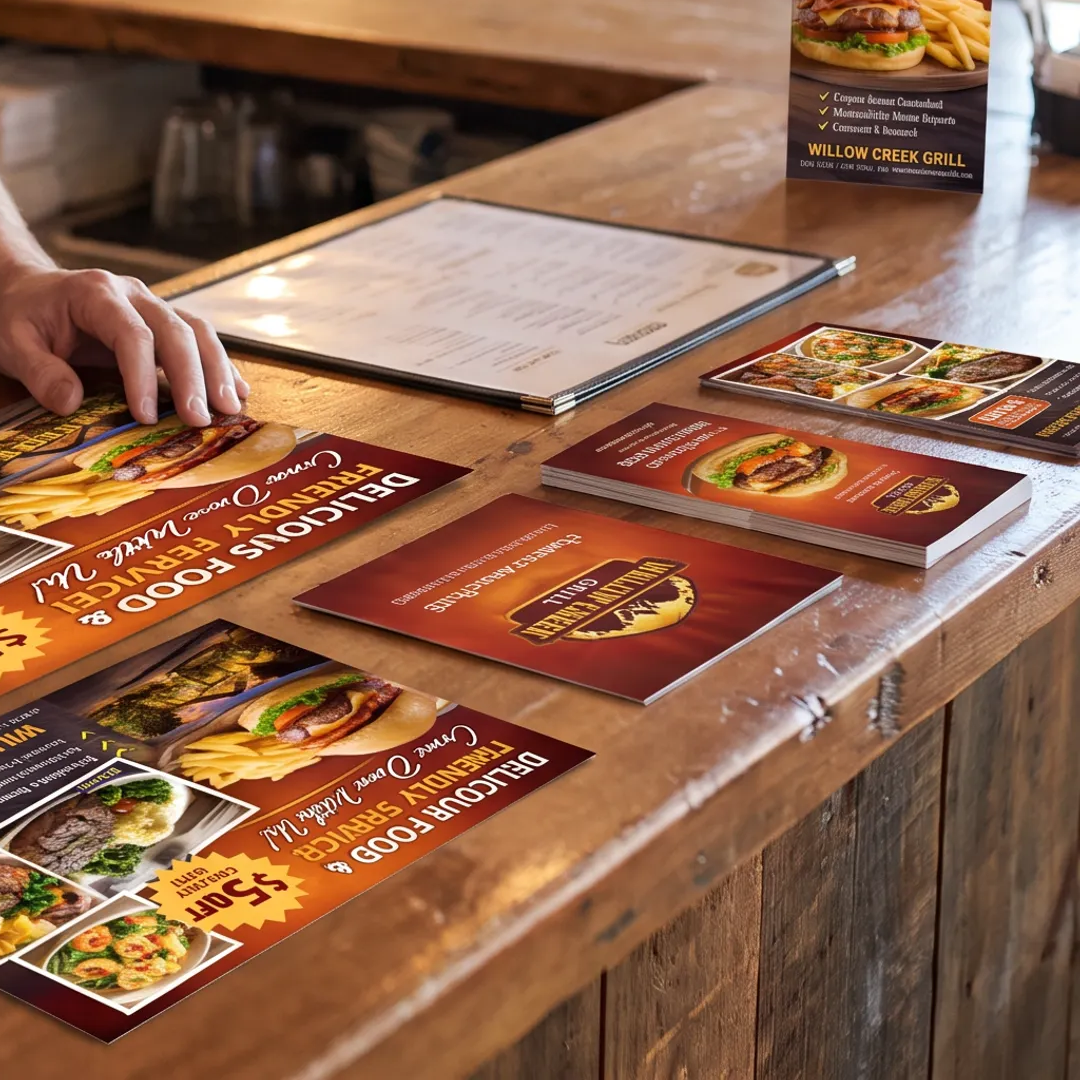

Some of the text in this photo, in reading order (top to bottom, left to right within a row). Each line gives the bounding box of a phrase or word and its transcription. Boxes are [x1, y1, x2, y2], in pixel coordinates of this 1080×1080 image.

[808, 142, 967, 168] WILLOW CREEK GRILL
[229, 472, 419, 559] DELICIOUS
[117, 557, 235, 612] FOOD
[350, 816, 434, 863] FOOD
